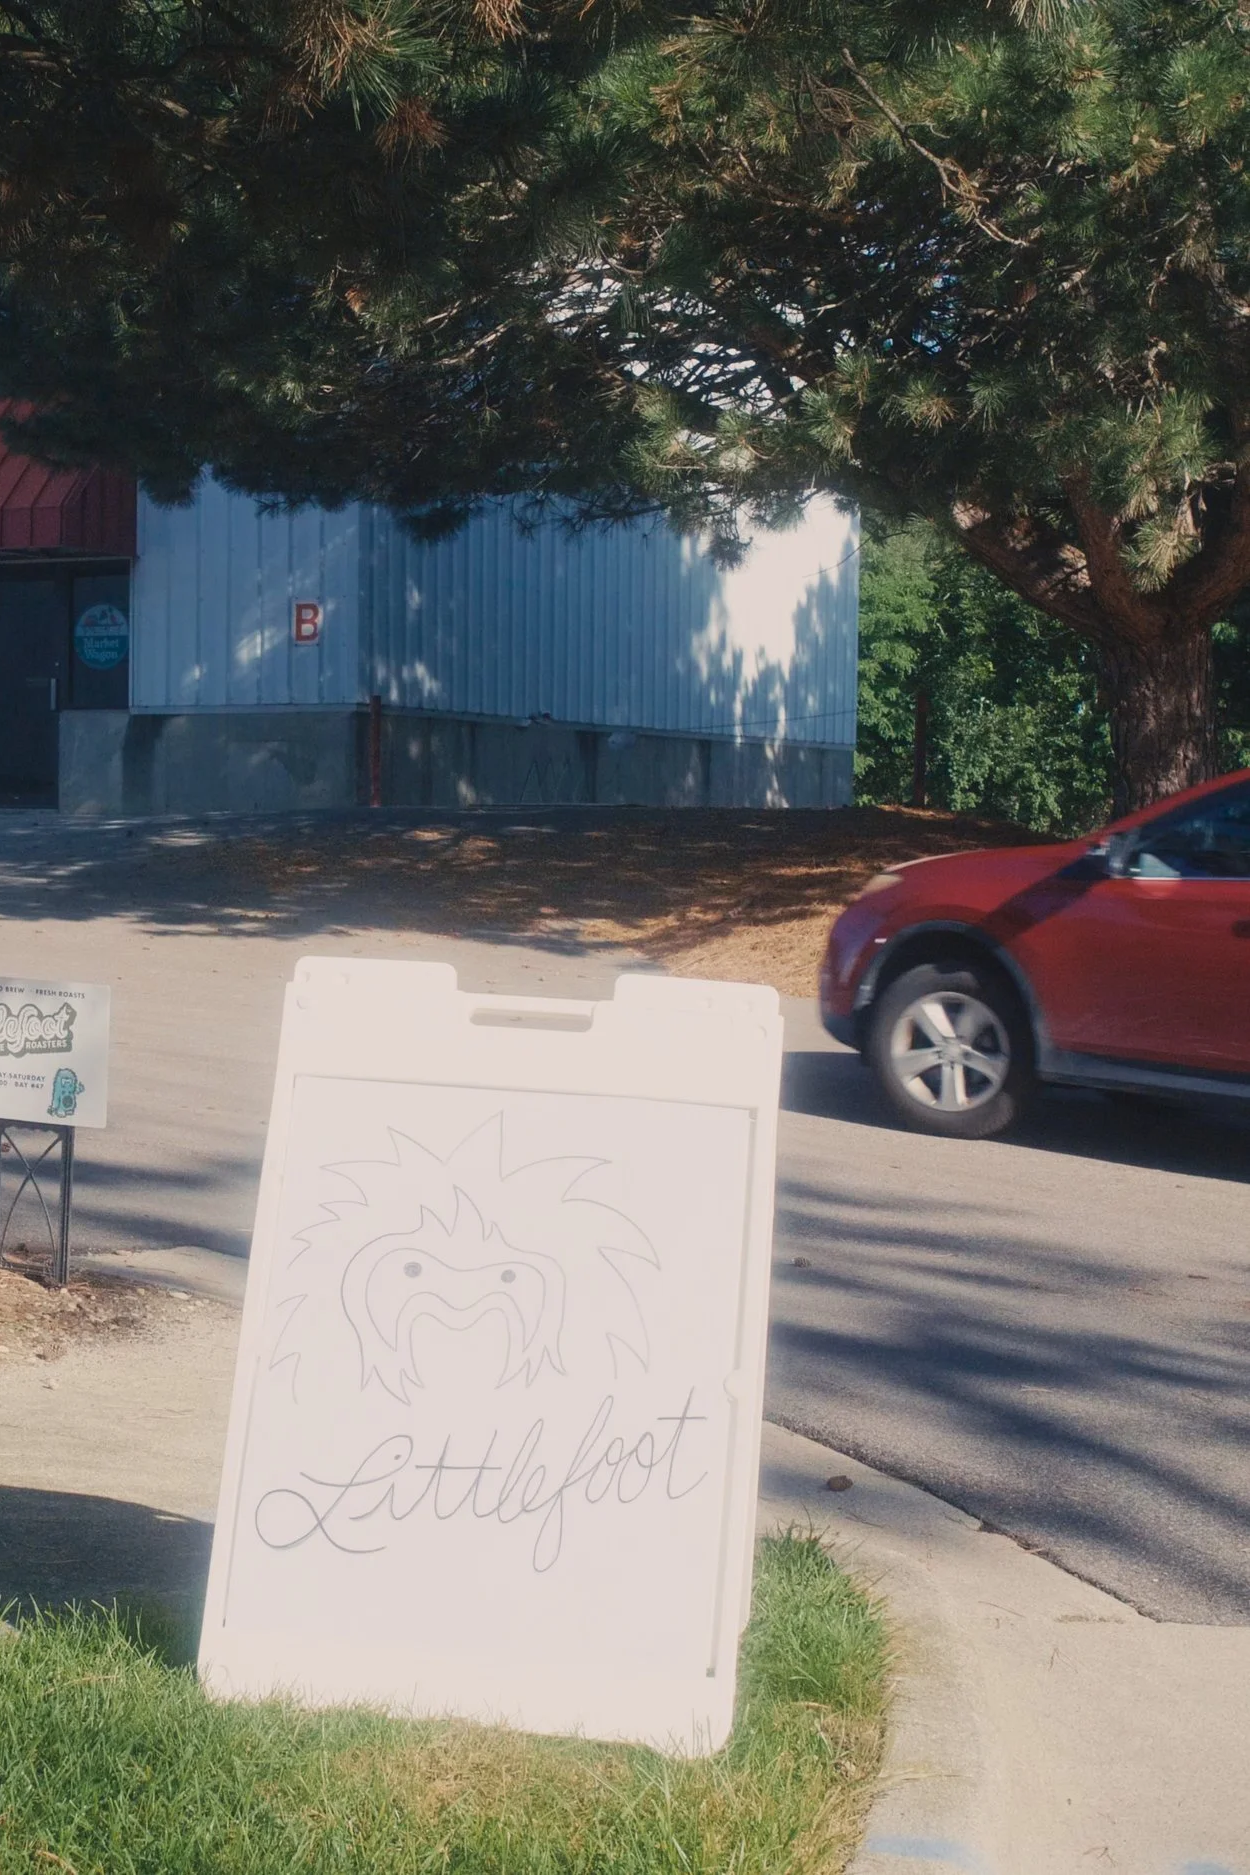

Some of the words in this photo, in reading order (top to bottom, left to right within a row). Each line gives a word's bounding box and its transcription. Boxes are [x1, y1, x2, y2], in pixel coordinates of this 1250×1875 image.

[296, 603, 320, 641] B
[5, 986, 25, 994] BREW
[35, 988, 57, 997] FRESH
[58, 990, 86, 999] ROASTS
[25, 1039, 68, 1050] ROASTERS
[255, 1386, 707, 1572] Littlefoot
